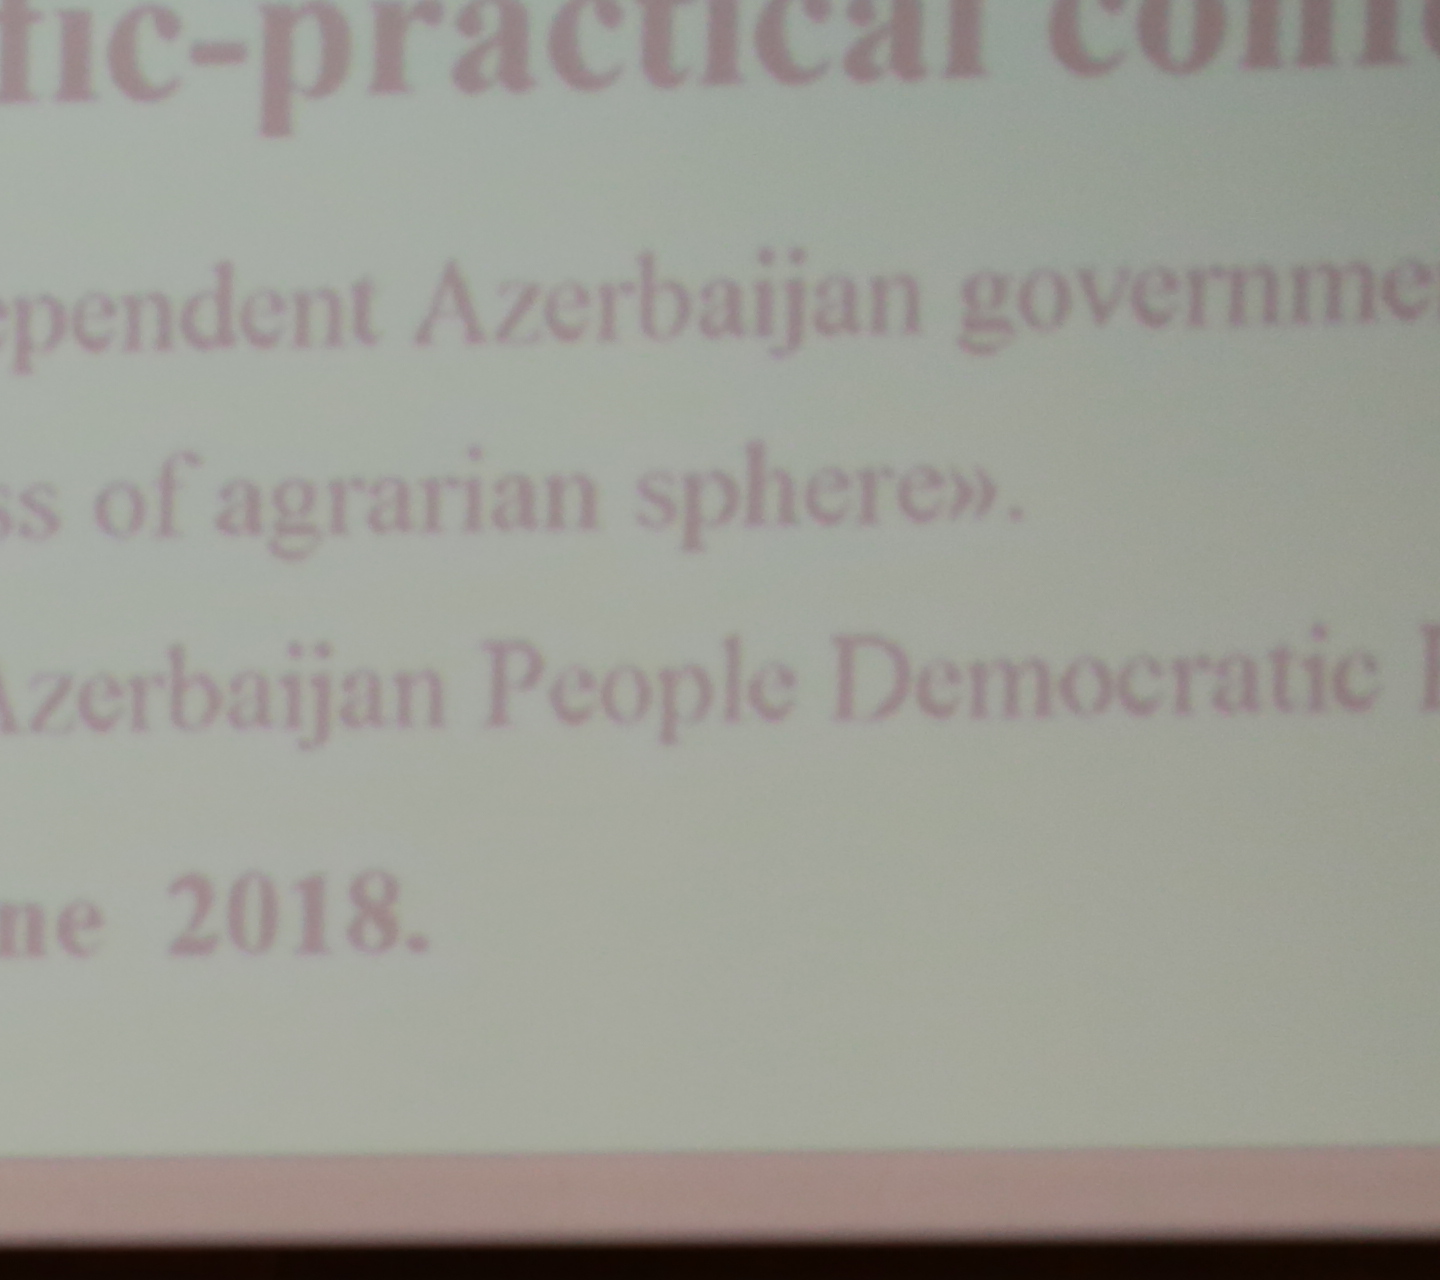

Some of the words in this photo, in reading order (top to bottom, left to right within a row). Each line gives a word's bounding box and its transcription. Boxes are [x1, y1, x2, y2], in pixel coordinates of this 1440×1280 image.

[413, 247, 921, 360] Azerbaijan
[957, 259, 1440, 358] governme
[93, 450, 201, 543] of
[214, 444, 598, 562] agrarian
[636, 440, 1024, 555] sphere».
[482, 634, 793, 747] People
[832, 623, 1378, 724] Democratic
[168, 870, 430, 959] 2018.
